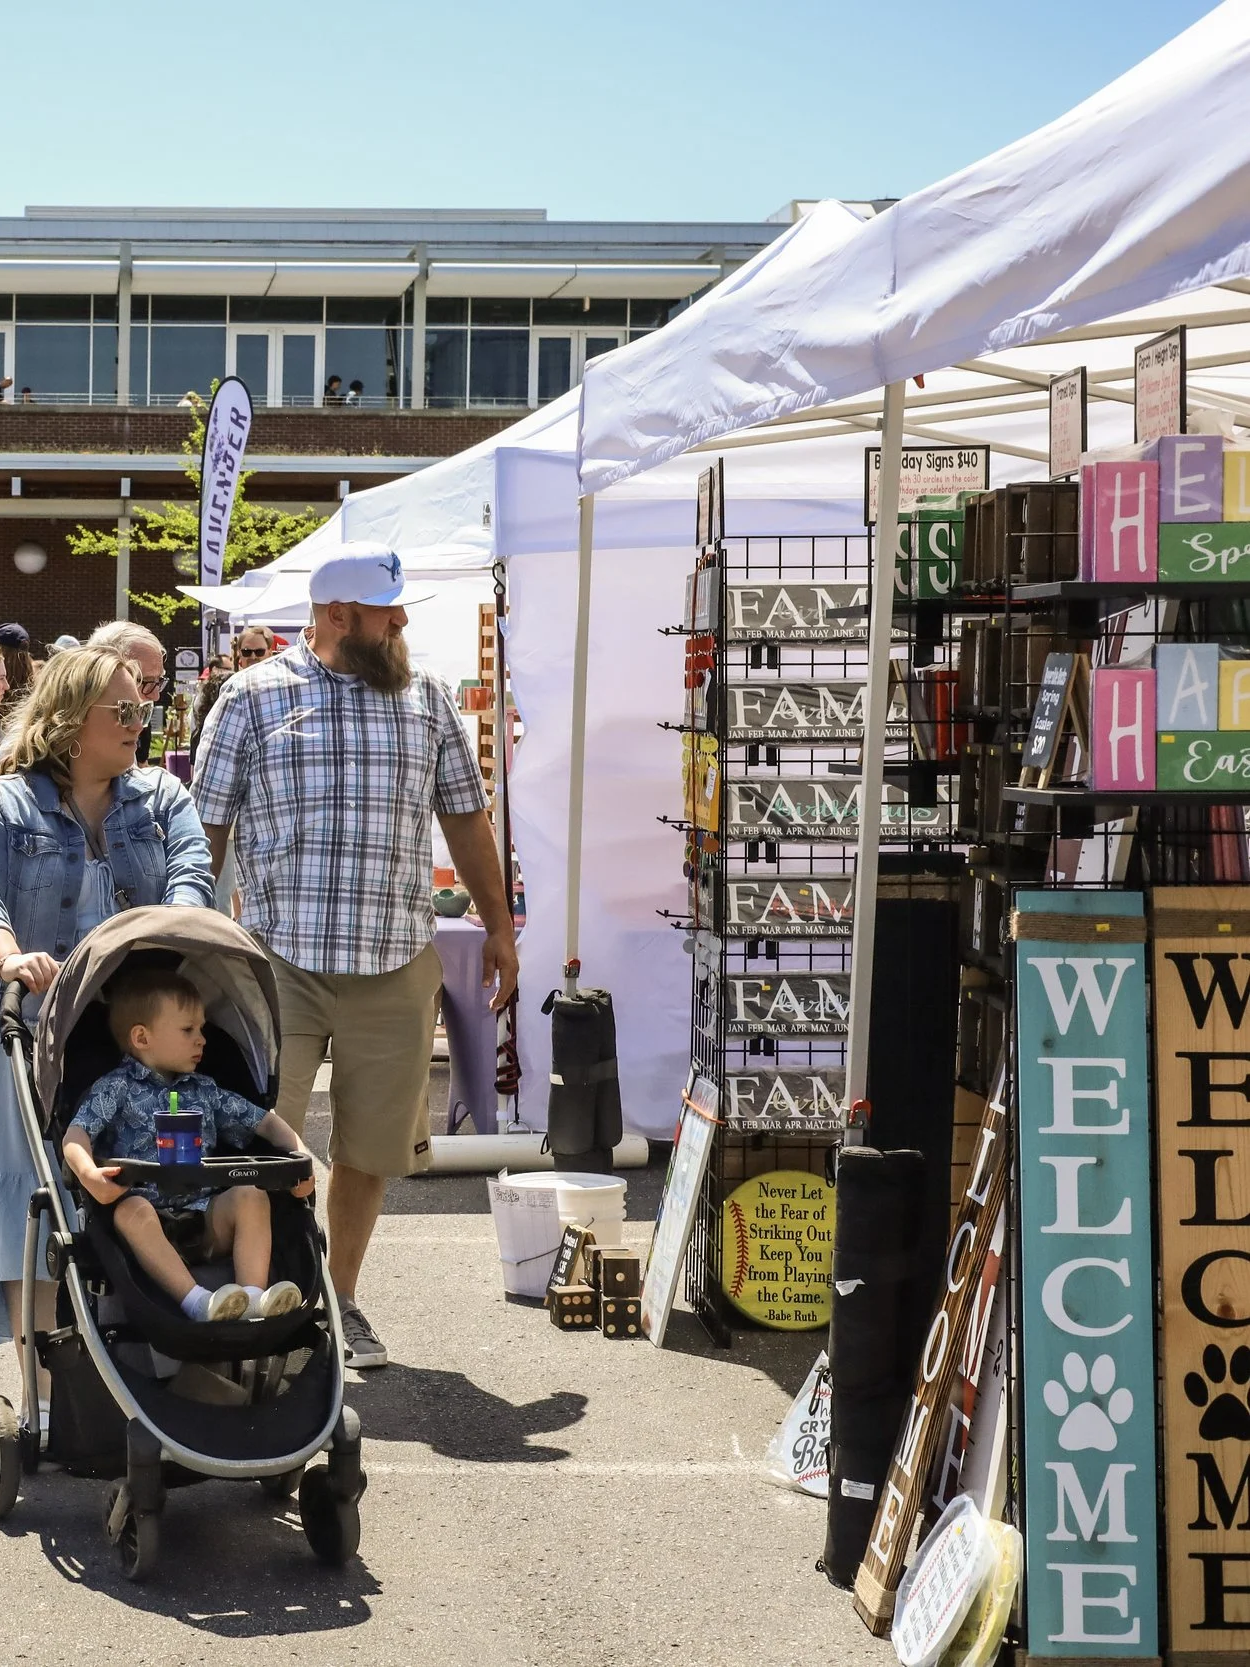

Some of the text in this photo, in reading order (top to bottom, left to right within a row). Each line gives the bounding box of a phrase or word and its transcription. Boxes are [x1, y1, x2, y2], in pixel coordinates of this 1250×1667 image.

[874, 451, 978, 472] Bday Signs $40
[912, 474, 922, 483] 30
[922, 474, 943, 483] circles
[945, 475, 951, 483] in
[952, 473, 962, 483] the
[963, 473, 979, 483] color
[870, 486, 877, 495] of
[746, 629, 762, 638] FEB
[766, 629, 786, 638] MAR
[789, 629, 807, 638] APR
[809, 629, 829, 638] MAY
[832, 629, 855, 638] JUNE
[951, 628, 962, 637] NO
[1041, 690, 1060, 706] Spring
[1034, 716, 1054, 731] Easter
[728, 728, 903, 738] JAN FEB MAR APR MAY JUNE AUG
[726, 827, 740, 835] AN
[743, 826, 759, 835] FEB
[763, 826, 783, 835] MAR
[786, 826, 803, 835] APR
[806, 826, 826, 835] MAY
[829, 826, 851, 835] JUNE
[879, 827, 897, 835] AUG
[924, 827, 942, 835] OCT
[726, 925, 850, 934] AN FEB MAR APR MAY JUNE
[727, 1023, 850, 1033] JAN FEB MAR APR MAY JUN
[742, 1120, 758, 1129] FEB
[761, 1120, 782, 1129] MAR
[785, 1120, 802, 1129] APR
[805, 1120, 824, 1129] MAY
[828, 1120, 845, 1129] JUN
[232, 1168, 256, 1178] GRACO
[758, 1181, 824, 1200] Never Let
[755, 1203, 827, 1221] the Fear of
[749, 1223, 833, 1246] Striking Out
[759, 1244, 823, 1267] Keep You
[747, 1264, 833, 1289] from Playing
[757, 1286, 825, 1304] the Game.
[764, 1309, 818, 1322] -Babe Ruth
[800, 1419, 831, 1434] CRY
